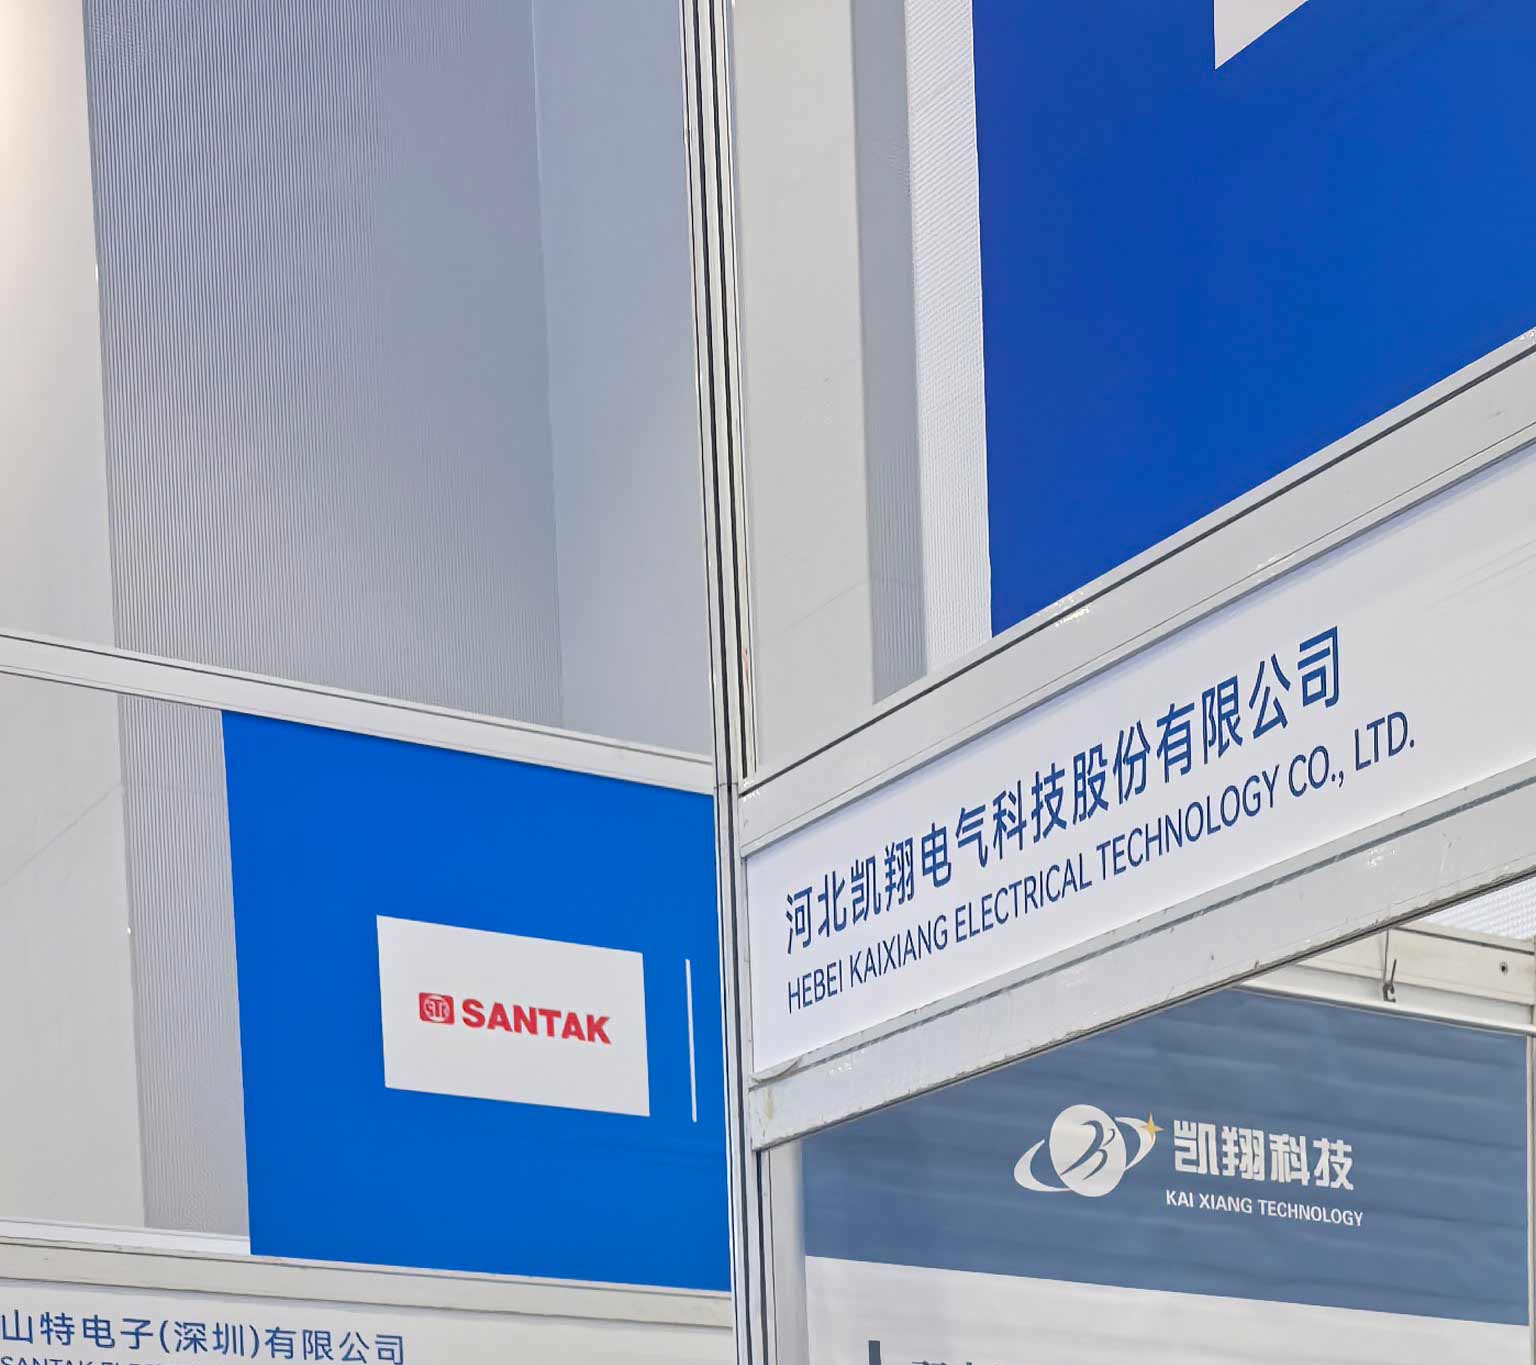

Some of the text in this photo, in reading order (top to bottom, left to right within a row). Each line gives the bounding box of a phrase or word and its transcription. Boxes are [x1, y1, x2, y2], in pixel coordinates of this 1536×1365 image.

[785, 626, 1342, 954] 河北凯翔电气科技股份有限公司
[786, 710, 1416, 1014] HEBEI KAIXIANG ELECTRICAL TECHNOLOGY CO., LTD.
[462, 998, 611, 1045] SANTAK
[1173, 1119, 1354, 1191] 凯翔科技
[1166, 1190, 1363, 1227] KAI XIANG TECHNOLOGY
